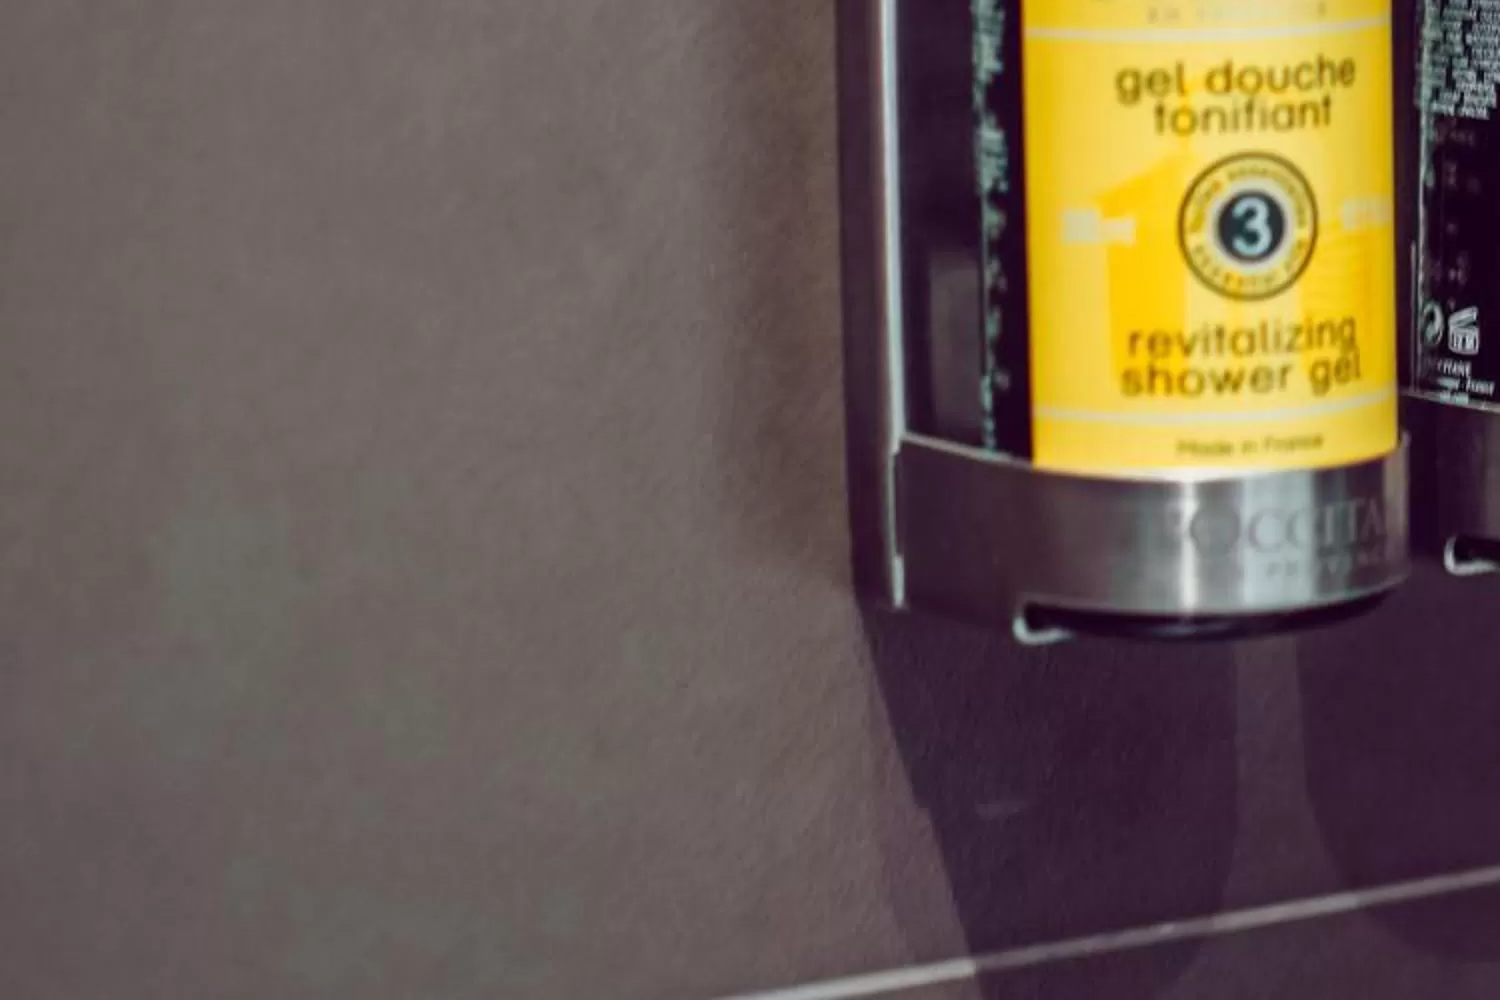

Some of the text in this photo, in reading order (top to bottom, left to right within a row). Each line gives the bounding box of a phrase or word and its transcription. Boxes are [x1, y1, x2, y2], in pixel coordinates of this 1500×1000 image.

[1114, 53, 1356, 105] gel douche
[1154, 94, 1333, 137] tonifiant
[1231, 194, 1275, 258] 3
[1127, 315, 1357, 361] revitalizing
[1120, 349, 1361, 398] shower gel
